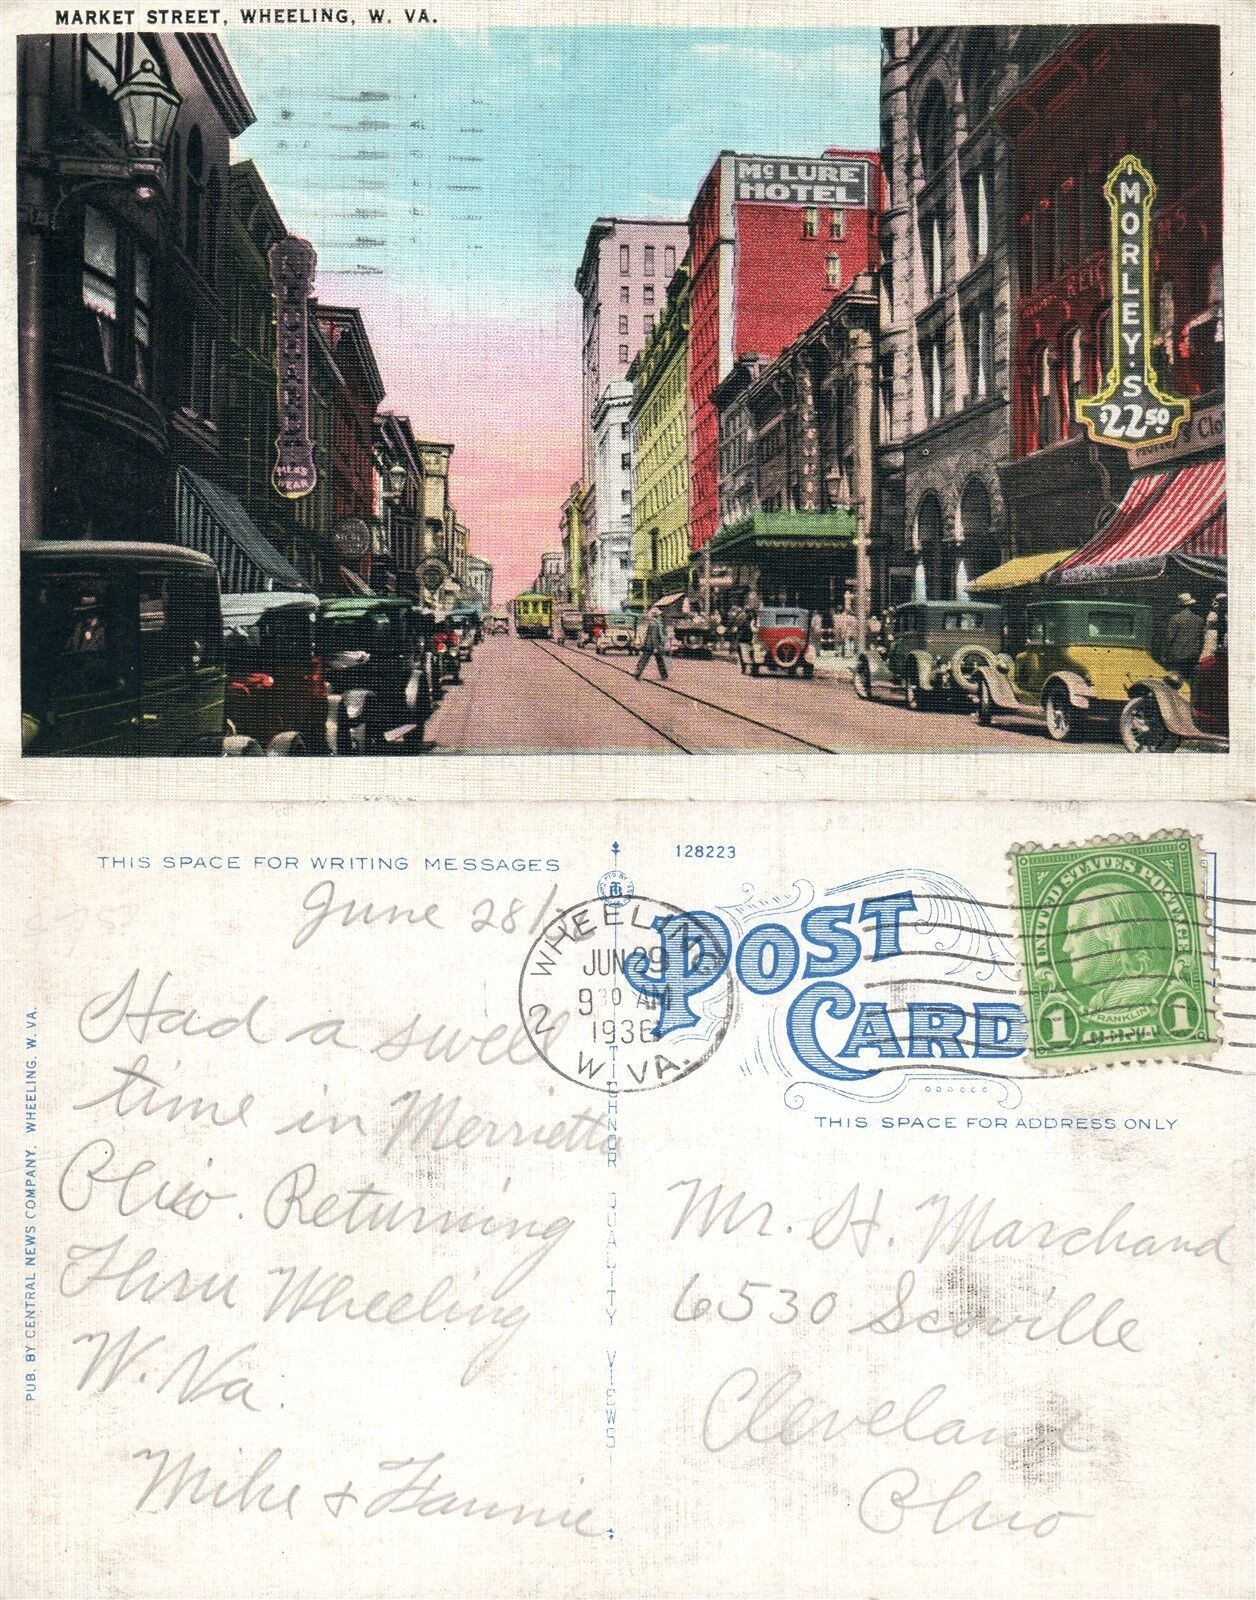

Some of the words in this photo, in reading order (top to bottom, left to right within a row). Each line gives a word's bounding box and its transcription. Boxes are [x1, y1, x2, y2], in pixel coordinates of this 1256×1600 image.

[56, 9, 135, 25] MARKET
[147, 9, 228, 25] STREET,
[241, 8, 356, 25] WHEELING,
[369, 9, 393, 24] W.
[405, 9, 437, 24] VA.
[740, 183, 860, 203] HOTEL
[99, 856, 151, 868] THIS
[163, 856, 240, 870] SPACE
[254, 857, 299, 870] FOR
[310, 857, 409, 871] WRITING
[424, 858, 560, 872] MESSAGES
[676, 844, 736, 859] 128223
[292, 880, 444, 949] June
[530, 903, 722, 977] WHEELING
[1035, 884, 1064, 964] UNITED
[1060, 857, 1137, 887] STATES
[1137, 867, 1190, 952] POSTAGE
[583, 948, 625, 976] JUN
[633, 946, 669, 974] 29
[624, 890, 917, 1039] POST
[25, 1033, 37, 1049] W.
[26, 1007, 37, 1029] VA.
[79, 968, 269, 1045] Had
[286, 1017, 358, 1050] a
[370, 1005, 572, 1067] swell
[528, 1003, 556, 1035] 2
[592, 1019, 662, 1044] 1936
[786, 981, 1029, 1082] CARD
[1045, 1007, 1072, 1043] 1
[1168, 996, 1196, 1033] 1
[73, 1055, 255, 1127] time
[275, 1084, 368, 1137] in
[626, 1053, 691, 1084] VA.
[606, 1045, 619, 1168] TICHNOR
[814, 1116, 867, 1128] THIS
[881, 1116, 957, 1129] SPACE
[966, 1116, 1009, 1129] FOR
[1015, 1117, 1116, 1130] ADDRESS
[1124, 1117, 1178, 1130] ONLY
[25, 1226, 36, 1266] NEWS
[263, 1162, 576, 1297] Returning
[668, 1177, 793, 1241] Mr.
[807, 1182, 895, 1258] H.
[915, 1193, 1238, 1266] Marchand
[605, 1192, 618, 1327] QUALITY
[25, 1273, 36, 1338] CENTRAL
[59, 1233, 237, 1308] Thru
[263, 1265, 531, 1387] Wheeling
[672, 1272, 840, 1325] 6530
[848, 1269, 1145, 1353] Scoville
[26, 1346, 37, 1362] BY
[26, 1369, 37, 1401] PUB.
[73, 1326, 165, 1392] W.
[157, 1342, 286, 1411] Va.
[605, 1350, 617, 1449] VIEWS
[702, 1366, 1092, 1453] Cleveland
[133, 1447, 300, 1520] Mike
[364, 1451, 608, 1538] Fannie
[858, 1466, 1093, 1539] Ohio
